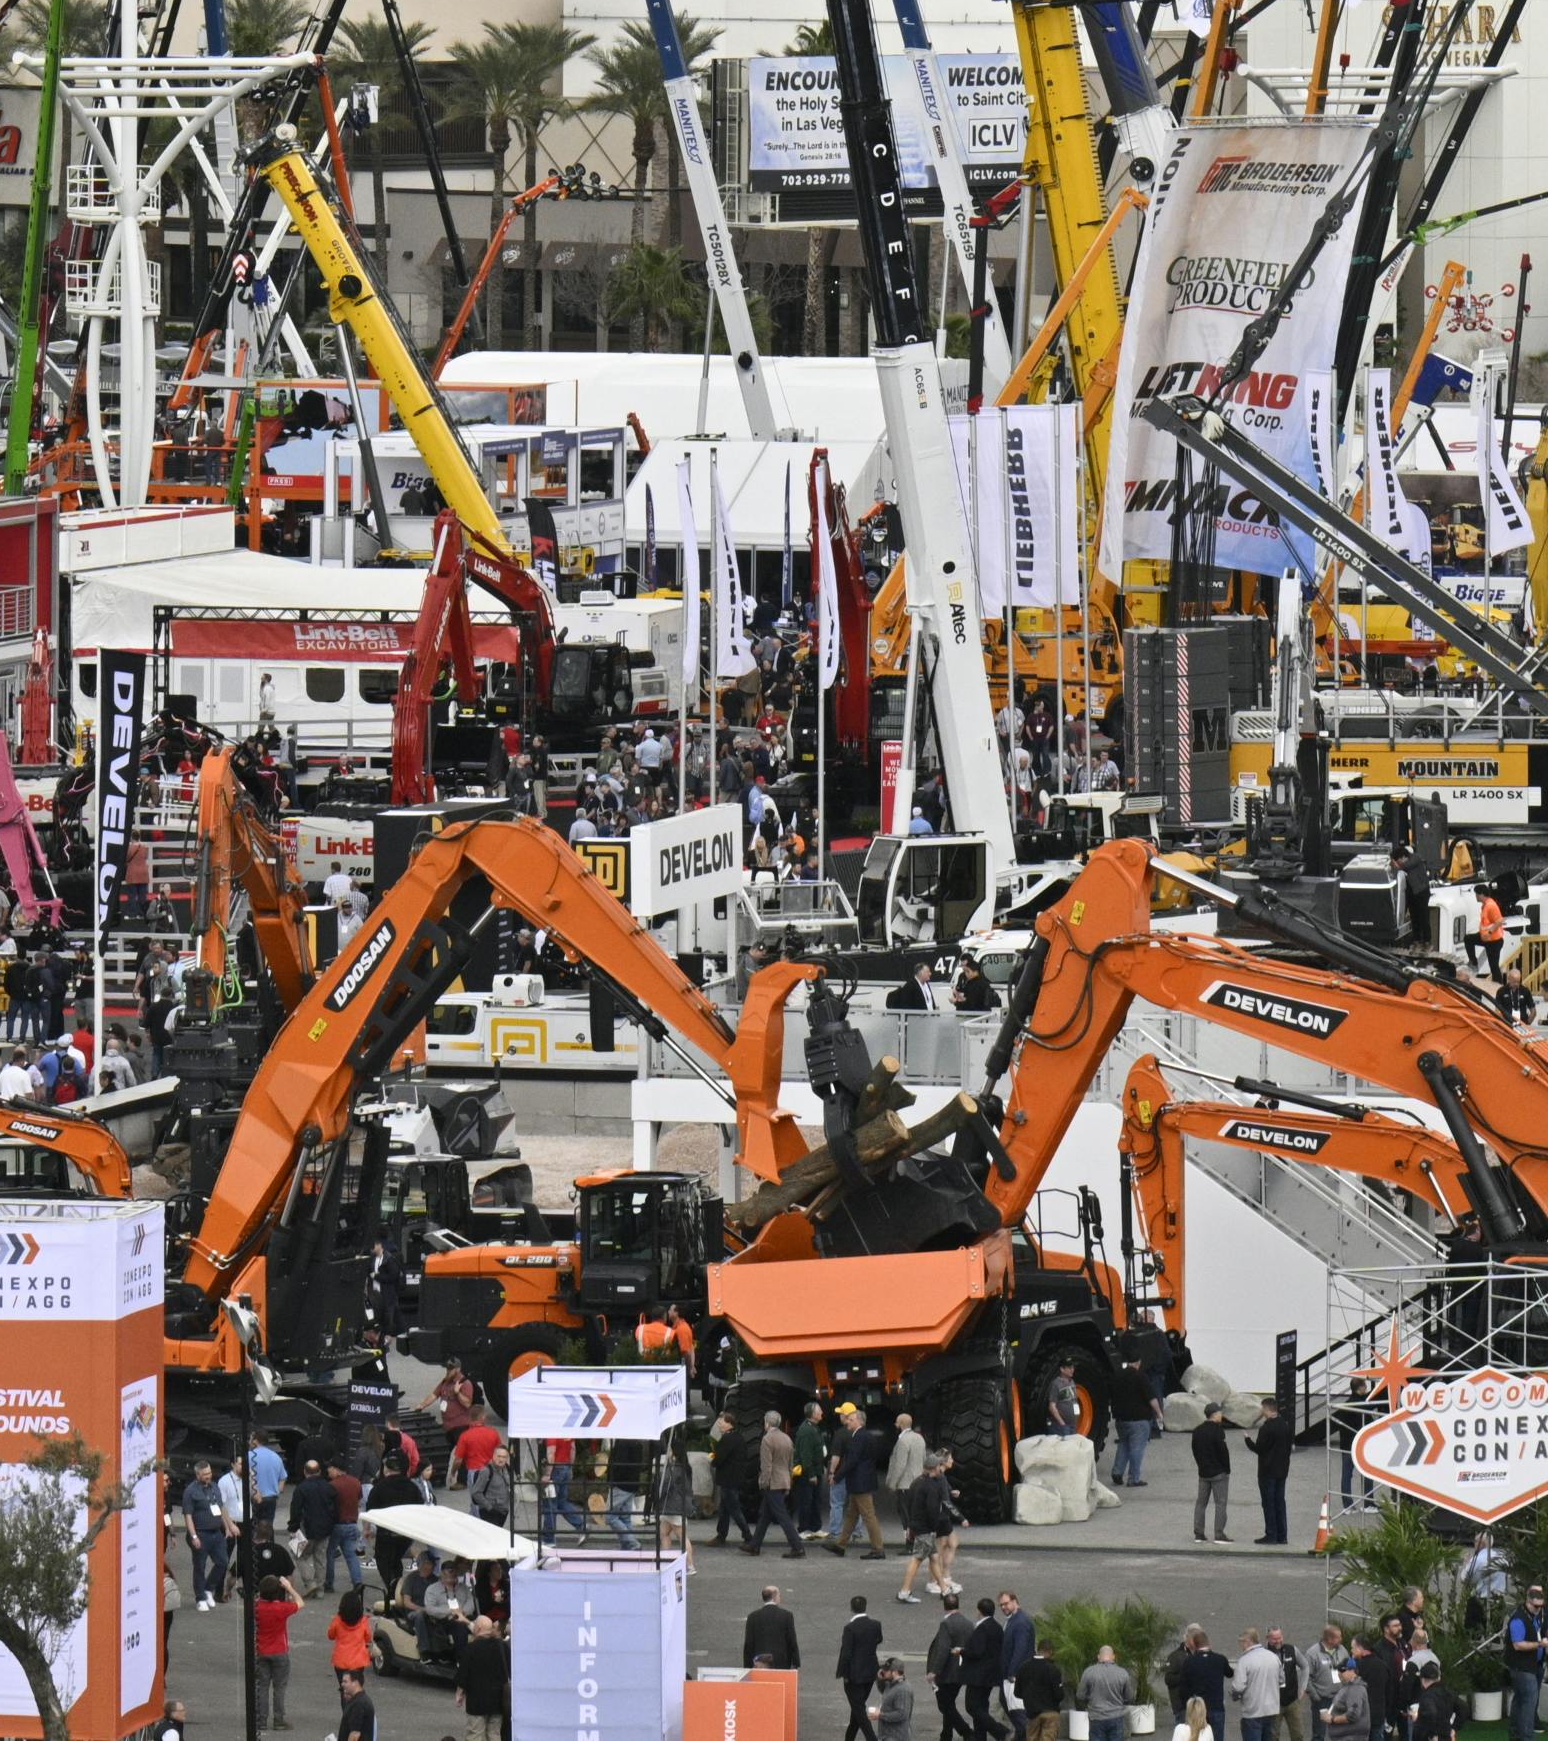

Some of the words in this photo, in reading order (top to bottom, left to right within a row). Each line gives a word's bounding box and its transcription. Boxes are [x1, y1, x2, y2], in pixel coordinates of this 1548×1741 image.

[915, 59, 937, 110] MANITEX
[776, 97, 797, 111] the
[799, 96, 828, 115] Holy
[676, 97, 698, 151] MANITEX
[972, 123, 1015, 147] ICLV
[969, 169, 1018, 180] ICLV.com
[1240, 161, 1340, 184] BRODERSON
[1230, 180, 1292, 195] Manufacturing
[1296, 184, 1327, 198] Corp.
[953, 203, 975, 261] TC65159
[705, 223, 732, 288] TC50128X
[1170, 280, 1294, 318] PRODUCTS
[1242, 406, 1284, 433] Corp.
[1212, 519, 1280, 540] RODUCTS
[1311, 527, 1325, 542] LR
[1326, 536, 1350, 560] 1400
[1350, 555, 1367, 572] SX
[473, 557, 502, 584] Link-Belt
[293, 624, 398, 641] Link-Belt
[950, 604, 967, 644] Altec
[295, 639, 400, 651] EXCAVATORS
[1452, 790, 1468, 799] LR
[1471, 790, 1504, 799] 1400
[1507, 790, 1524, 800] SX
[348, 866, 372, 877] 260
[659, 831, 733, 887] DEVELON
[334, 926, 394, 1008] DOOSAN
[1223, 991, 1330, 1032] DEVELON
[10, 1121, 58, 1138] DOOSAN
[1236, 1126, 1318, 1151] DEVELON
[351, 1384, 393, 1398] DEVELON
